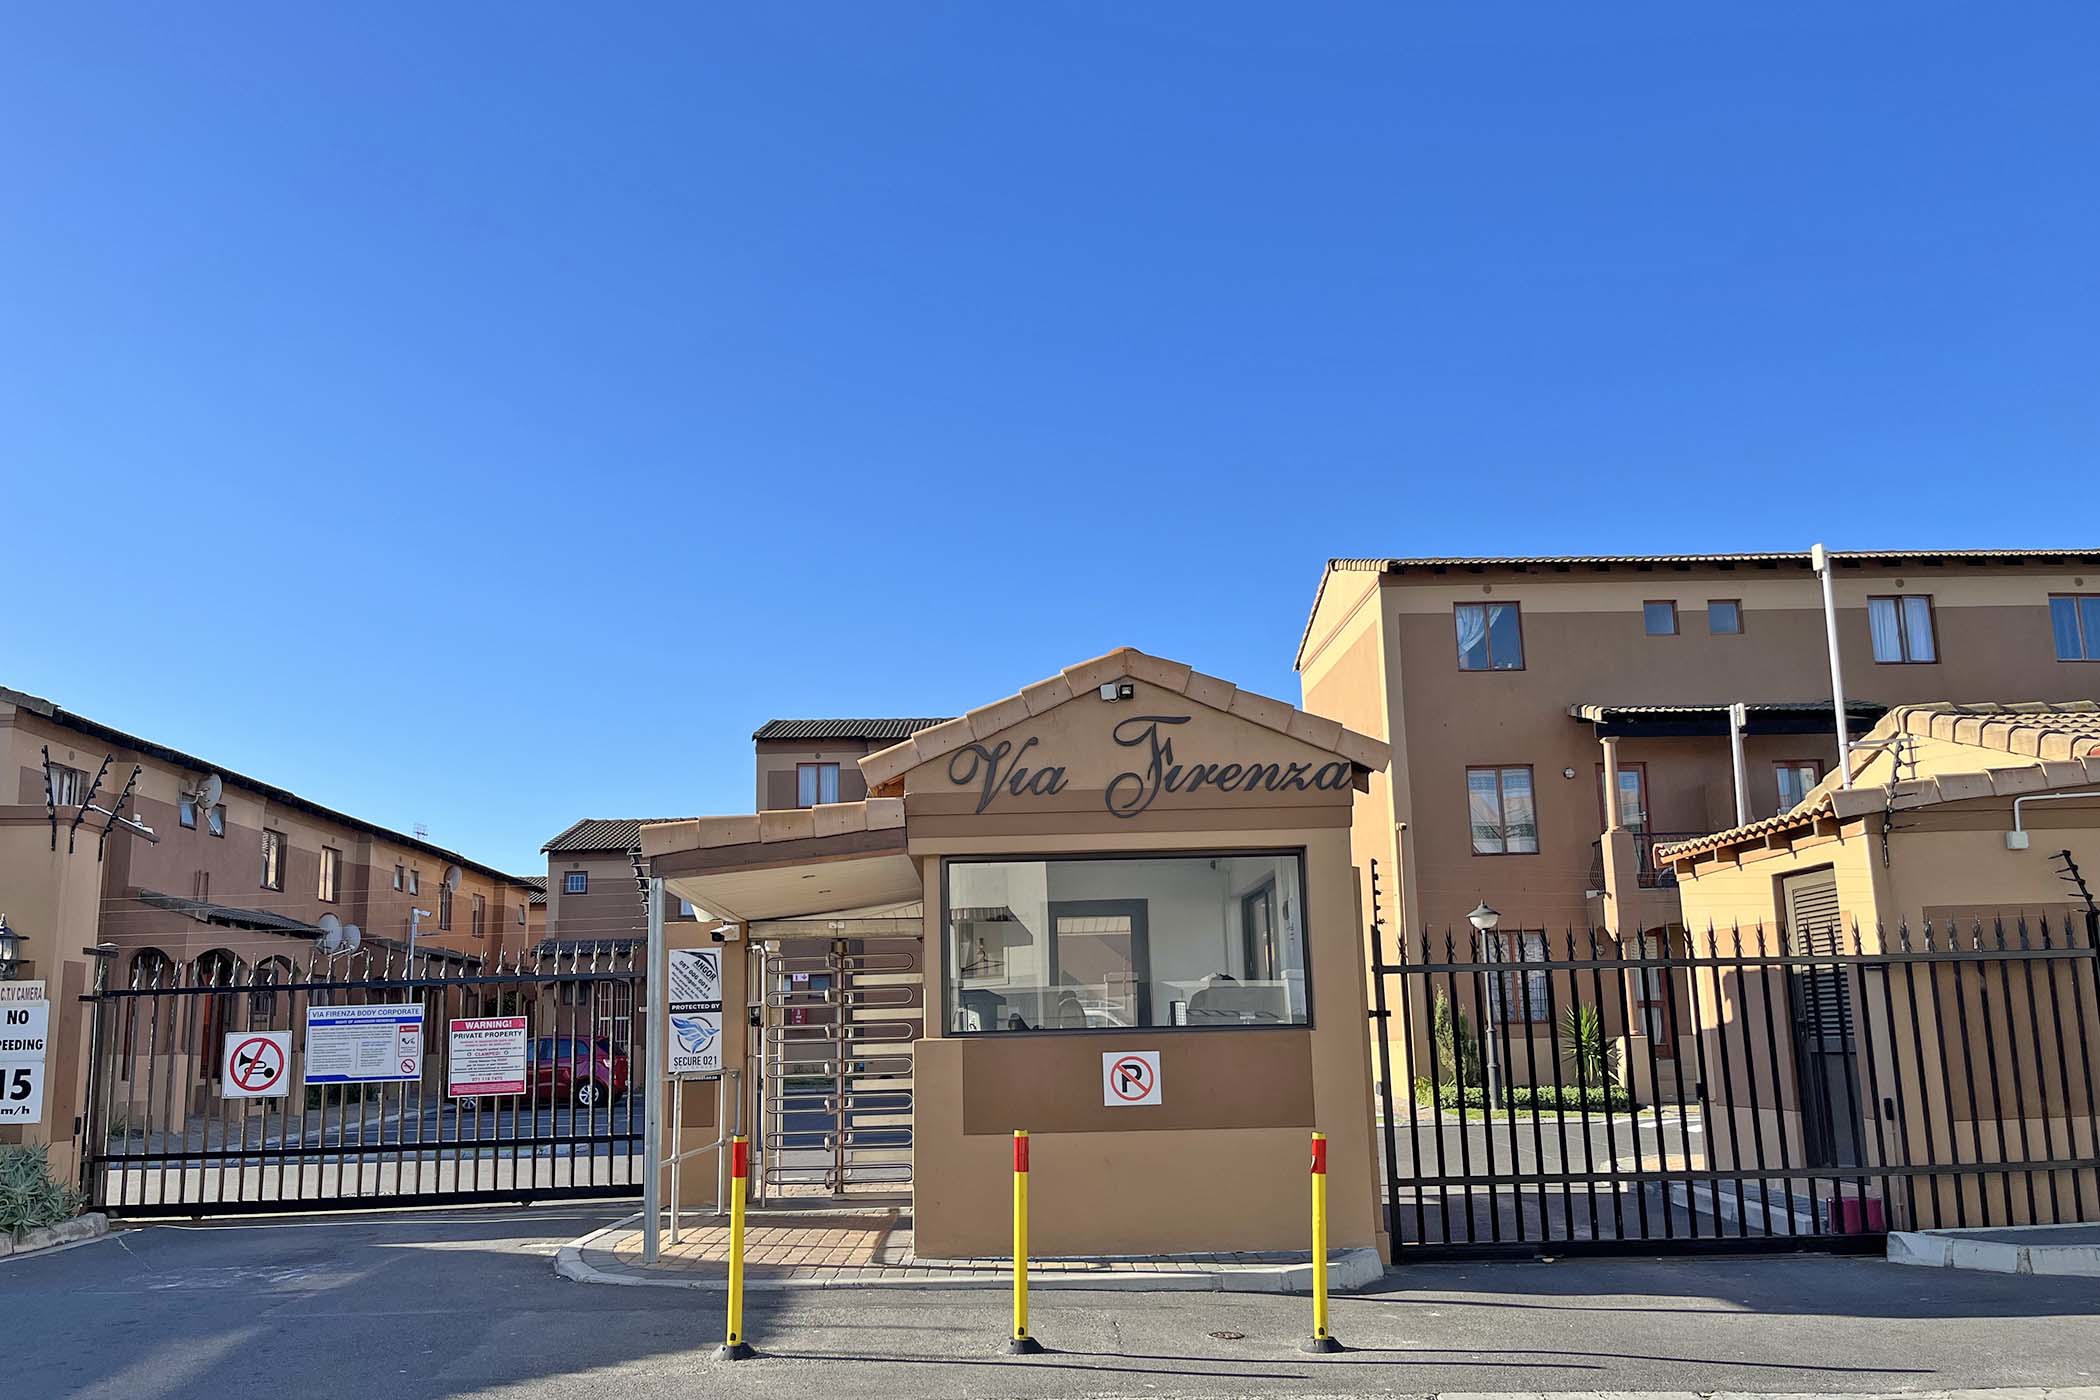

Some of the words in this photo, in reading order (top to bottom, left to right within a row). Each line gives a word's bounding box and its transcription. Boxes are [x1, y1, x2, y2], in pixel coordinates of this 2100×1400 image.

[949, 736, 1069, 815] Via
[1105, 715, 1352, 819] Firenza
[694, 959, 717, 981] ANGOR
[17, 987, 42, 1001] CAMERA
[312, 1010, 325, 1018] VIA
[325, 1009, 356, 1018] FIRENZA
[357, 1008, 376, 1017] BODY
[377, 1007, 420, 1016] CORPORATE
[671, 1003, 710, 1011] PROTECTED
[6, 1009, 30, 1025] NO
[464, 1020, 512, 1030] WARNING!
[673, 1055, 701, 1067] SECURE
[702, 1055, 717, 1066] 021
